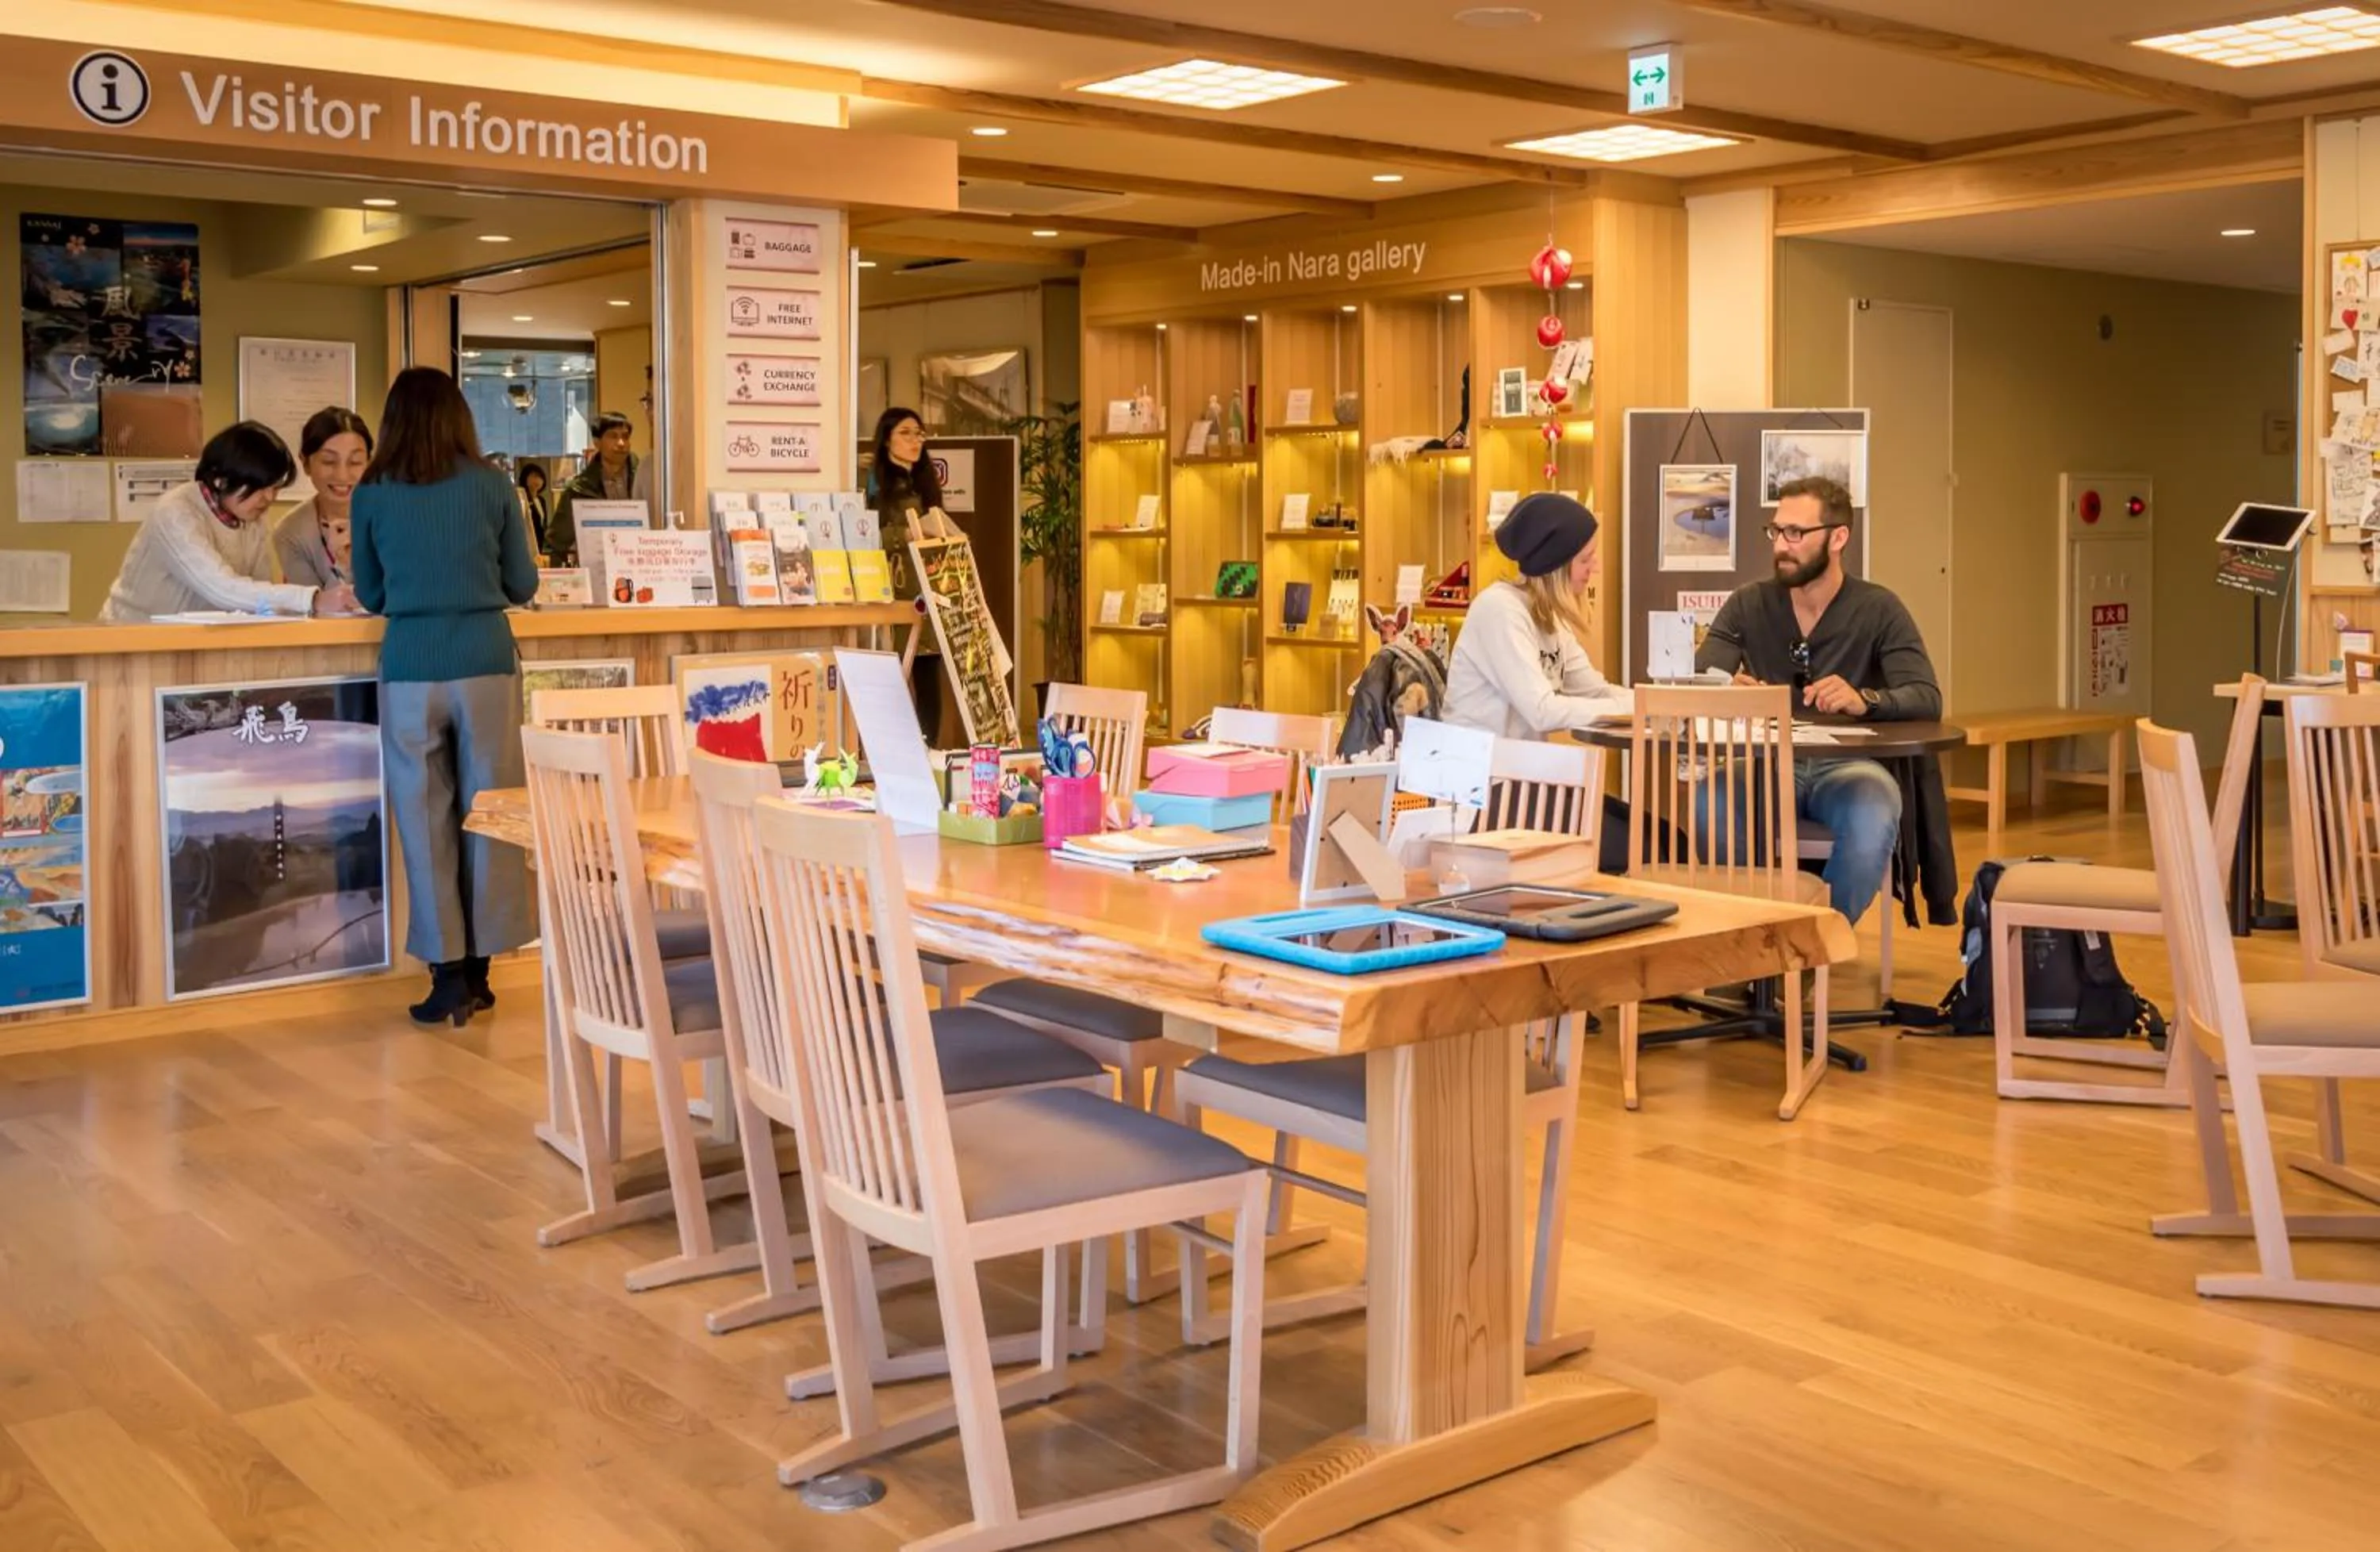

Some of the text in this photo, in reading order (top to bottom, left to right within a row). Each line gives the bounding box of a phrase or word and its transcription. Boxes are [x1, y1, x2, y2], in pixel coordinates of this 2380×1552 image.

[179, 71, 708, 174] Visitor Information
[764, 241, 812, 254] BAGGAGE
[1200, 240, 1426, 292] Made-in Nara gallery
[777, 303, 801, 313] FREE
[100, 286, 143, 363] 風景
[766, 315, 813, 326] INTERNET
[69, 354, 174, 394] Scenery
[764, 369, 816, 380] CURRENCY
[763, 382, 816, 392] EXCHANGE
[770, 448, 810, 458] BICYCLE
[1682, 596, 1724, 609] ISUIE
[232, 701, 309, 744] 飛鳥
